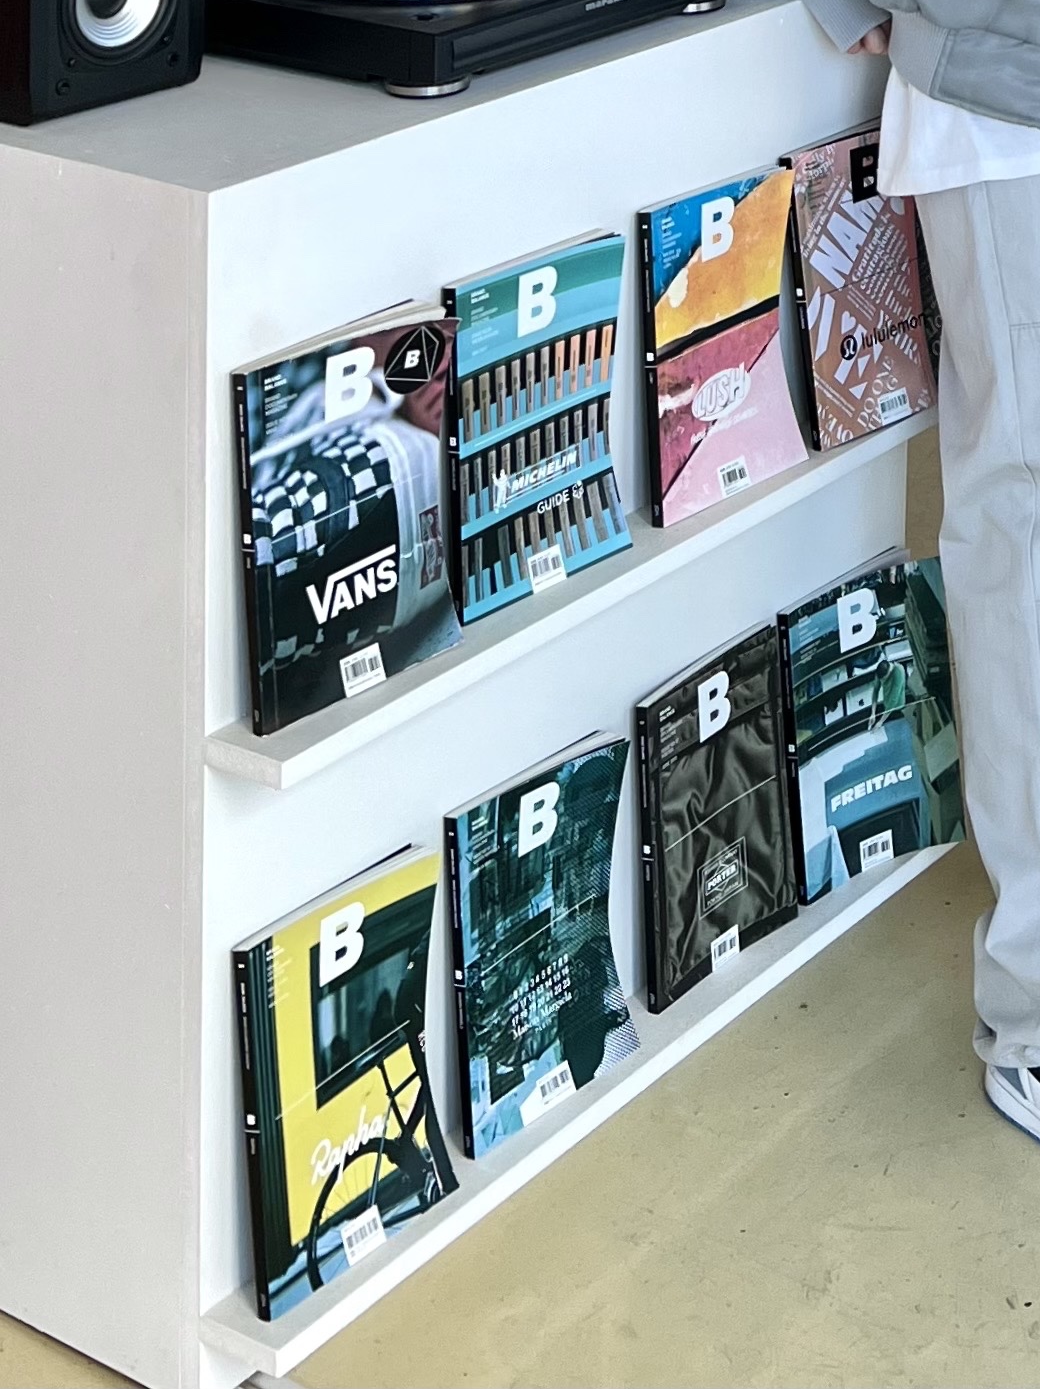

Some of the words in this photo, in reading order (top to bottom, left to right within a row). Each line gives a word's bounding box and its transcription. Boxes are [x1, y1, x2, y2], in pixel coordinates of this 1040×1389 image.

[701, 196, 735, 263] B
[517, 265, 558, 339] B
[862, 312, 926, 349] lululemon
[324, 346, 375, 423] B
[404, 349, 421, 369] B
[696, 362, 746, 417] LUSH
[510, 449, 578, 494] MICHELIN
[536, 492, 571, 515] GUIDE
[305, 544, 398, 625] VANS
[836, 587, 877, 653] B
[697, 670, 732, 743] B
[518, 781, 561, 859] B
[831, 764, 913, 813] FREITAG
[707, 864, 736, 891] PORTER
[319, 901, 365, 988] B
[310, 1106, 392, 1186] Rapha
